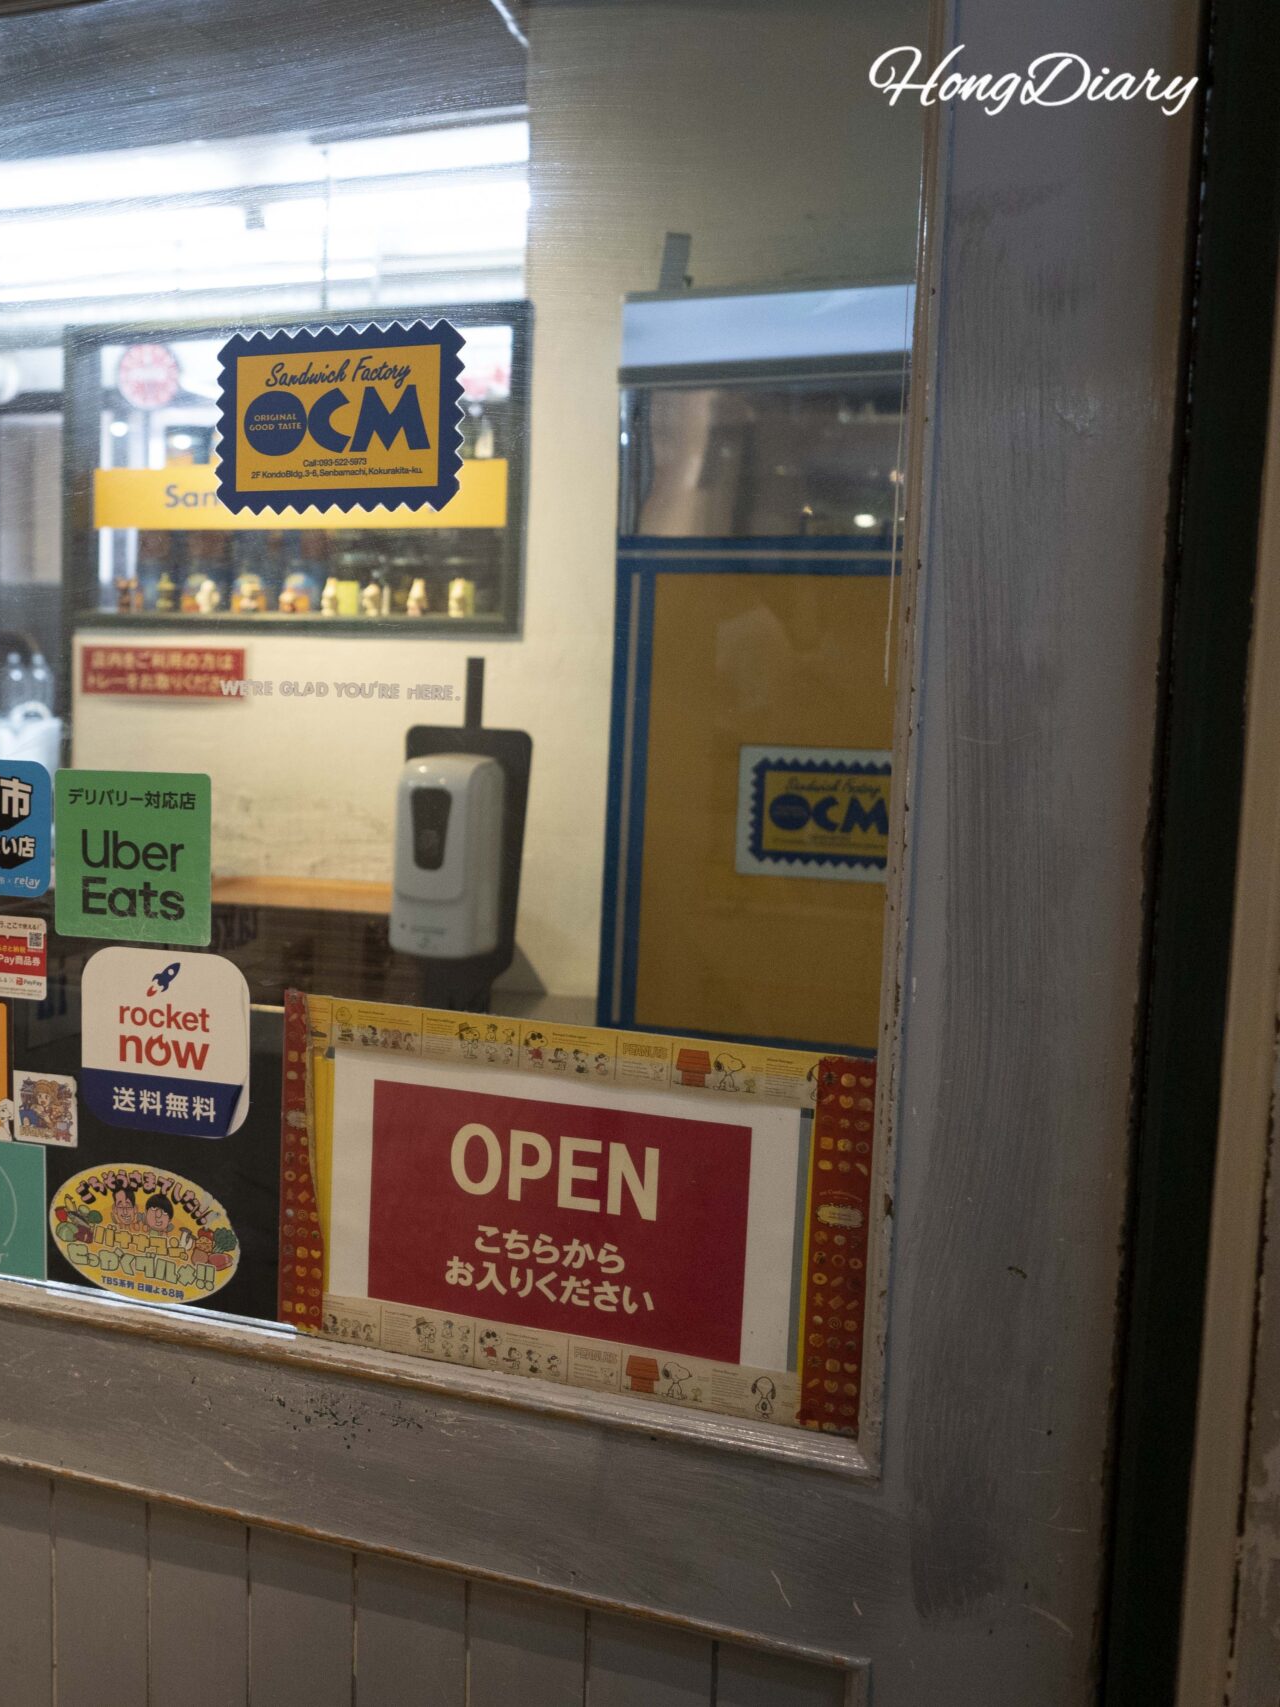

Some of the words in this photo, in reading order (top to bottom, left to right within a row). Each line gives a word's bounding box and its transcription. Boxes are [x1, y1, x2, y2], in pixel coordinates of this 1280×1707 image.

[265, 358, 351, 388] Sandwich
[352, 355, 411, 389] Factory
[243, 384, 431, 456] OCM
[249, 423, 275, 431] GOOD
[278, 422, 302, 430] TASTE
[254, 413, 297, 421] ORIGINAL
[251, 471, 260, 479] 2F
[279, 680, 329, 698] GLAD
[333, 680, 400, 699] YOU'RE
[68, 788, 197, 811] デリバリー対応店
[768, 793, 890, 835] OCM
[82, 829, 184, 873] Uber
[14, 875, 40, 889] relay
[82, 875, 185, 921] Eats
[119, 1003, 210, 1033] rocket
[119, 1033, 210, 1072] now
[112, 1086, 217, 1123] 送料無料
[450, 1122, 660, 1222] OPEN
[475, 1224, 626, 1275] こちらから
[444, 1255, 655, 1315] お入りください
